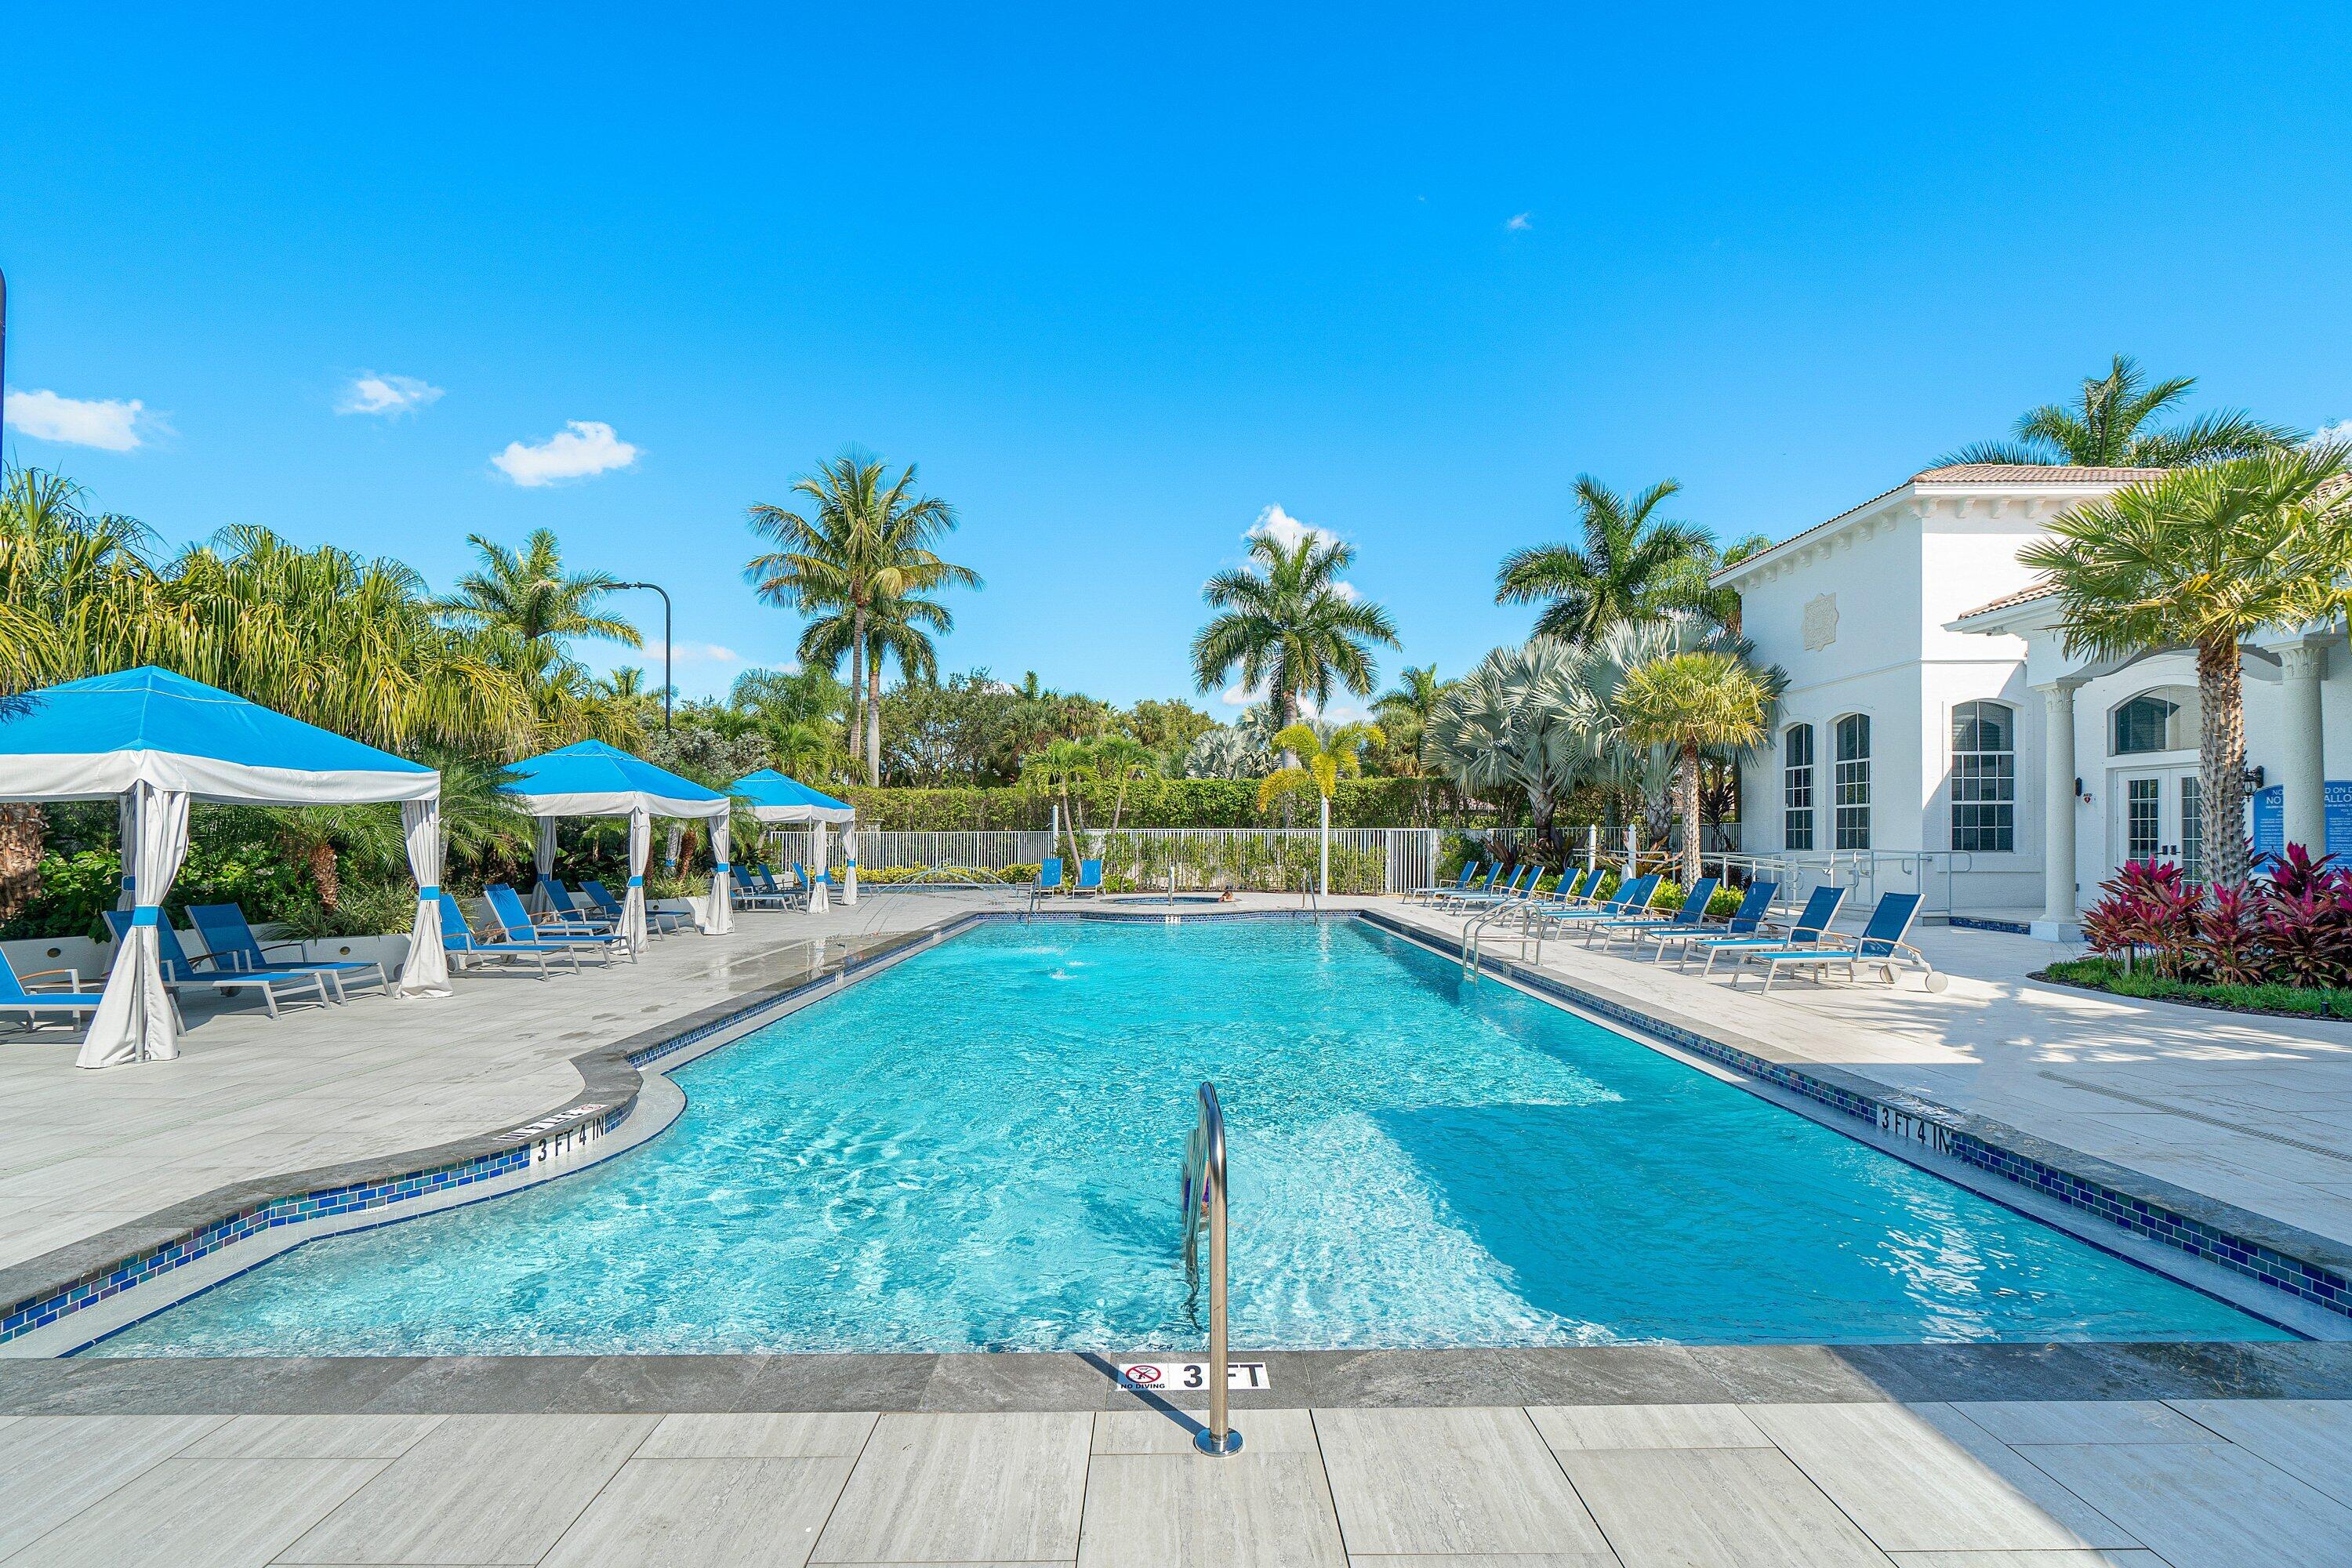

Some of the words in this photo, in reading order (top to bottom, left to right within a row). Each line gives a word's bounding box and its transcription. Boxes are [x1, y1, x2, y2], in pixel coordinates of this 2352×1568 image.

[2266, 796, 2281, 804] NO
[2324, 793, 2352, 803] ALLO
[538, 1139, 547, 1162] 3
[555, 1129, 573, 1156] FT
[579, 1123, 587, 1145] 4
[593, 1116, 604, 1141] IN
[1882, 1107, 1889, 1129] 3
[1895, 1112, 1911, 1138] FT
[1917, 1119, 1926, 1144] 4
[1933, 1125, 1950, 1154] IN
[1183, 1365, 1203, 1388] 3
